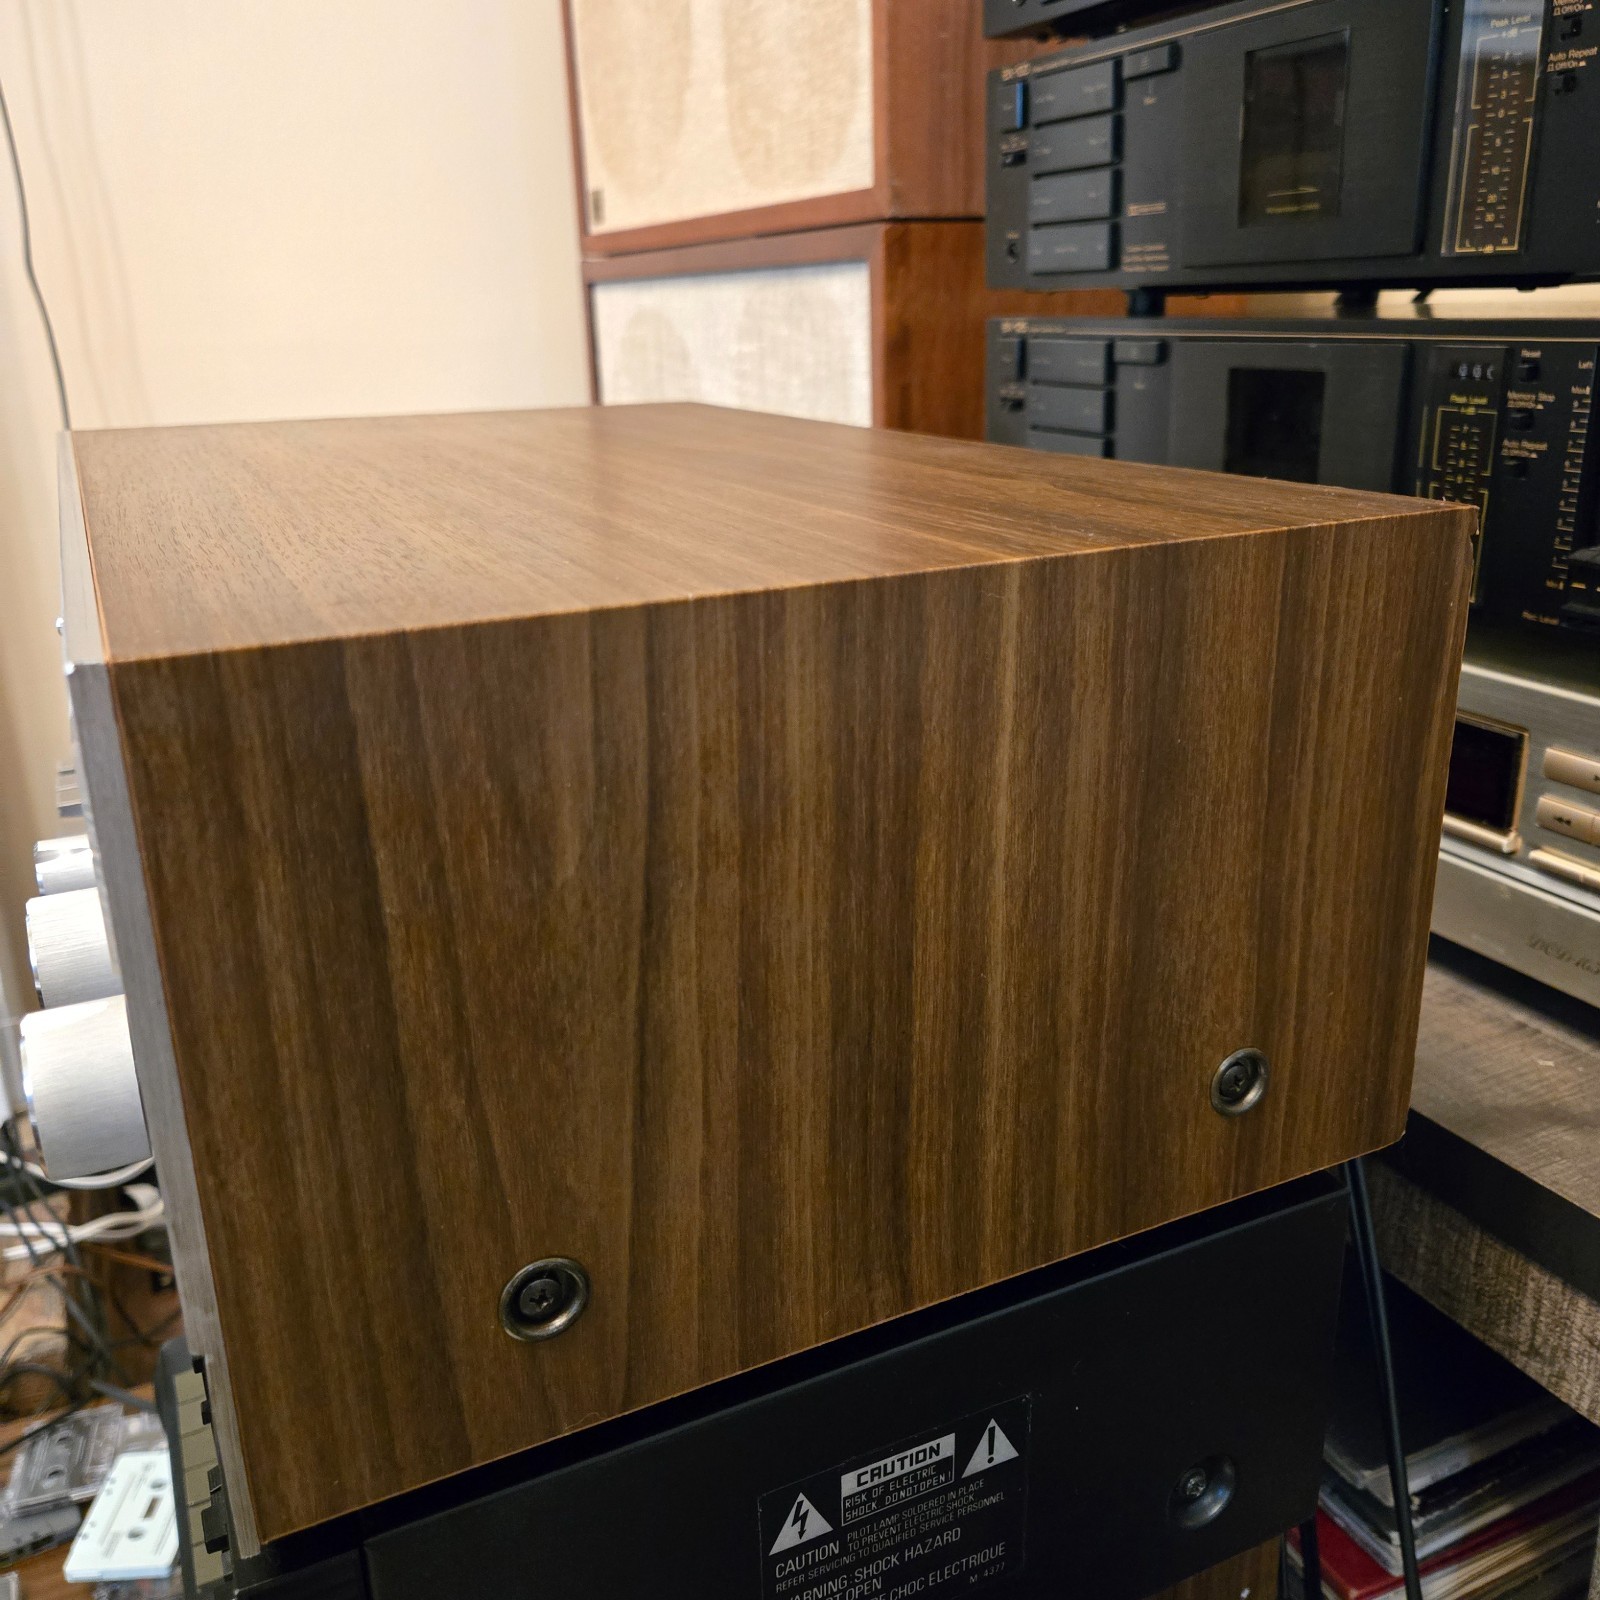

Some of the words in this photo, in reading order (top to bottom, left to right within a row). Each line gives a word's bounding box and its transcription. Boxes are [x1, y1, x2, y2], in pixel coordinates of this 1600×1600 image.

[845, 1491, 868, 1509] RISK
[872, 1485, 884, 1498] OF
[890, 1465, 937, 1491] ELECTRIC
[857, 1443, 940, 1487] CAUTION
[847, 1525, 871, 1542] PILOT
[873, 1513, 900, 1531] LAMP
[902, 1495, 946, 1520] SOLDERED
[947, 1490, 957, 1500] IN
[958, 1479, 985, 1497] PLACE
[848, 1540, 860, 1552] TO
[862, 1523, 901, 1547] PREVENT
[904, 1506, 947, 1529] ELECTRIC
[775, 1540, 840, 1578] CAUTION
[776, 1574, 805, 1593] REFER
[808, 1553, 856, 1580] SERVICING
[859, 1547, 870, 1558] TO
[872, 1528, 917, 1553] QUALIFIED
[919, 1512, 955, 1534] SERVICE
[957, 1491, 1005, 1517] PERSONNEL
[854, 1552, 900, 1583] SHOCK
[904, 1527, 961, 1562] HAZARD
[846, 1576, 882, 1600] OPEN
[890, 1577, 925, 1600] CHOC
[929, 1541, 1006, 1586] ELECTRIQUE
[969, 1573, 978, 1584] M
